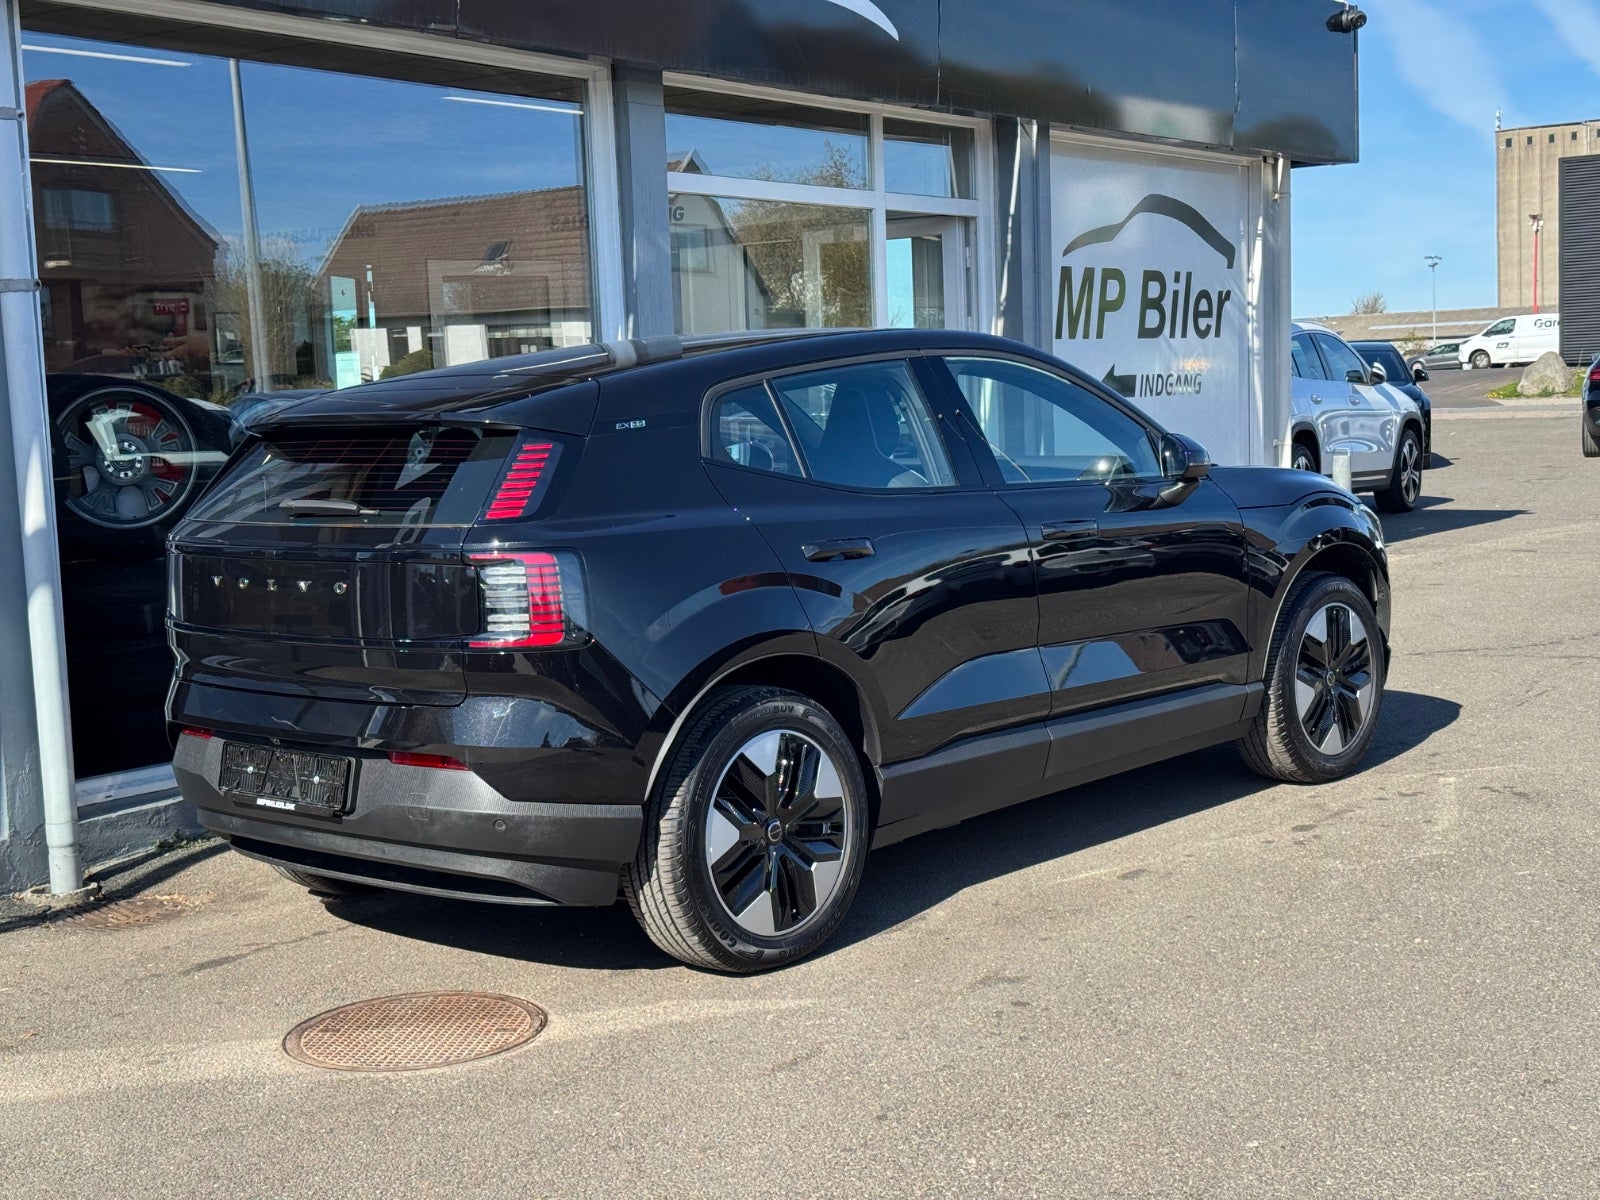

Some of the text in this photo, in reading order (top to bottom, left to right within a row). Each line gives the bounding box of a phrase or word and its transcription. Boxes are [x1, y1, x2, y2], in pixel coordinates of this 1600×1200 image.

[1055, 266, 1232, 340] MP Biler
[1139, 373, 1203, 398] INDGANG
[211, 575, 348, 595] VOLVO
